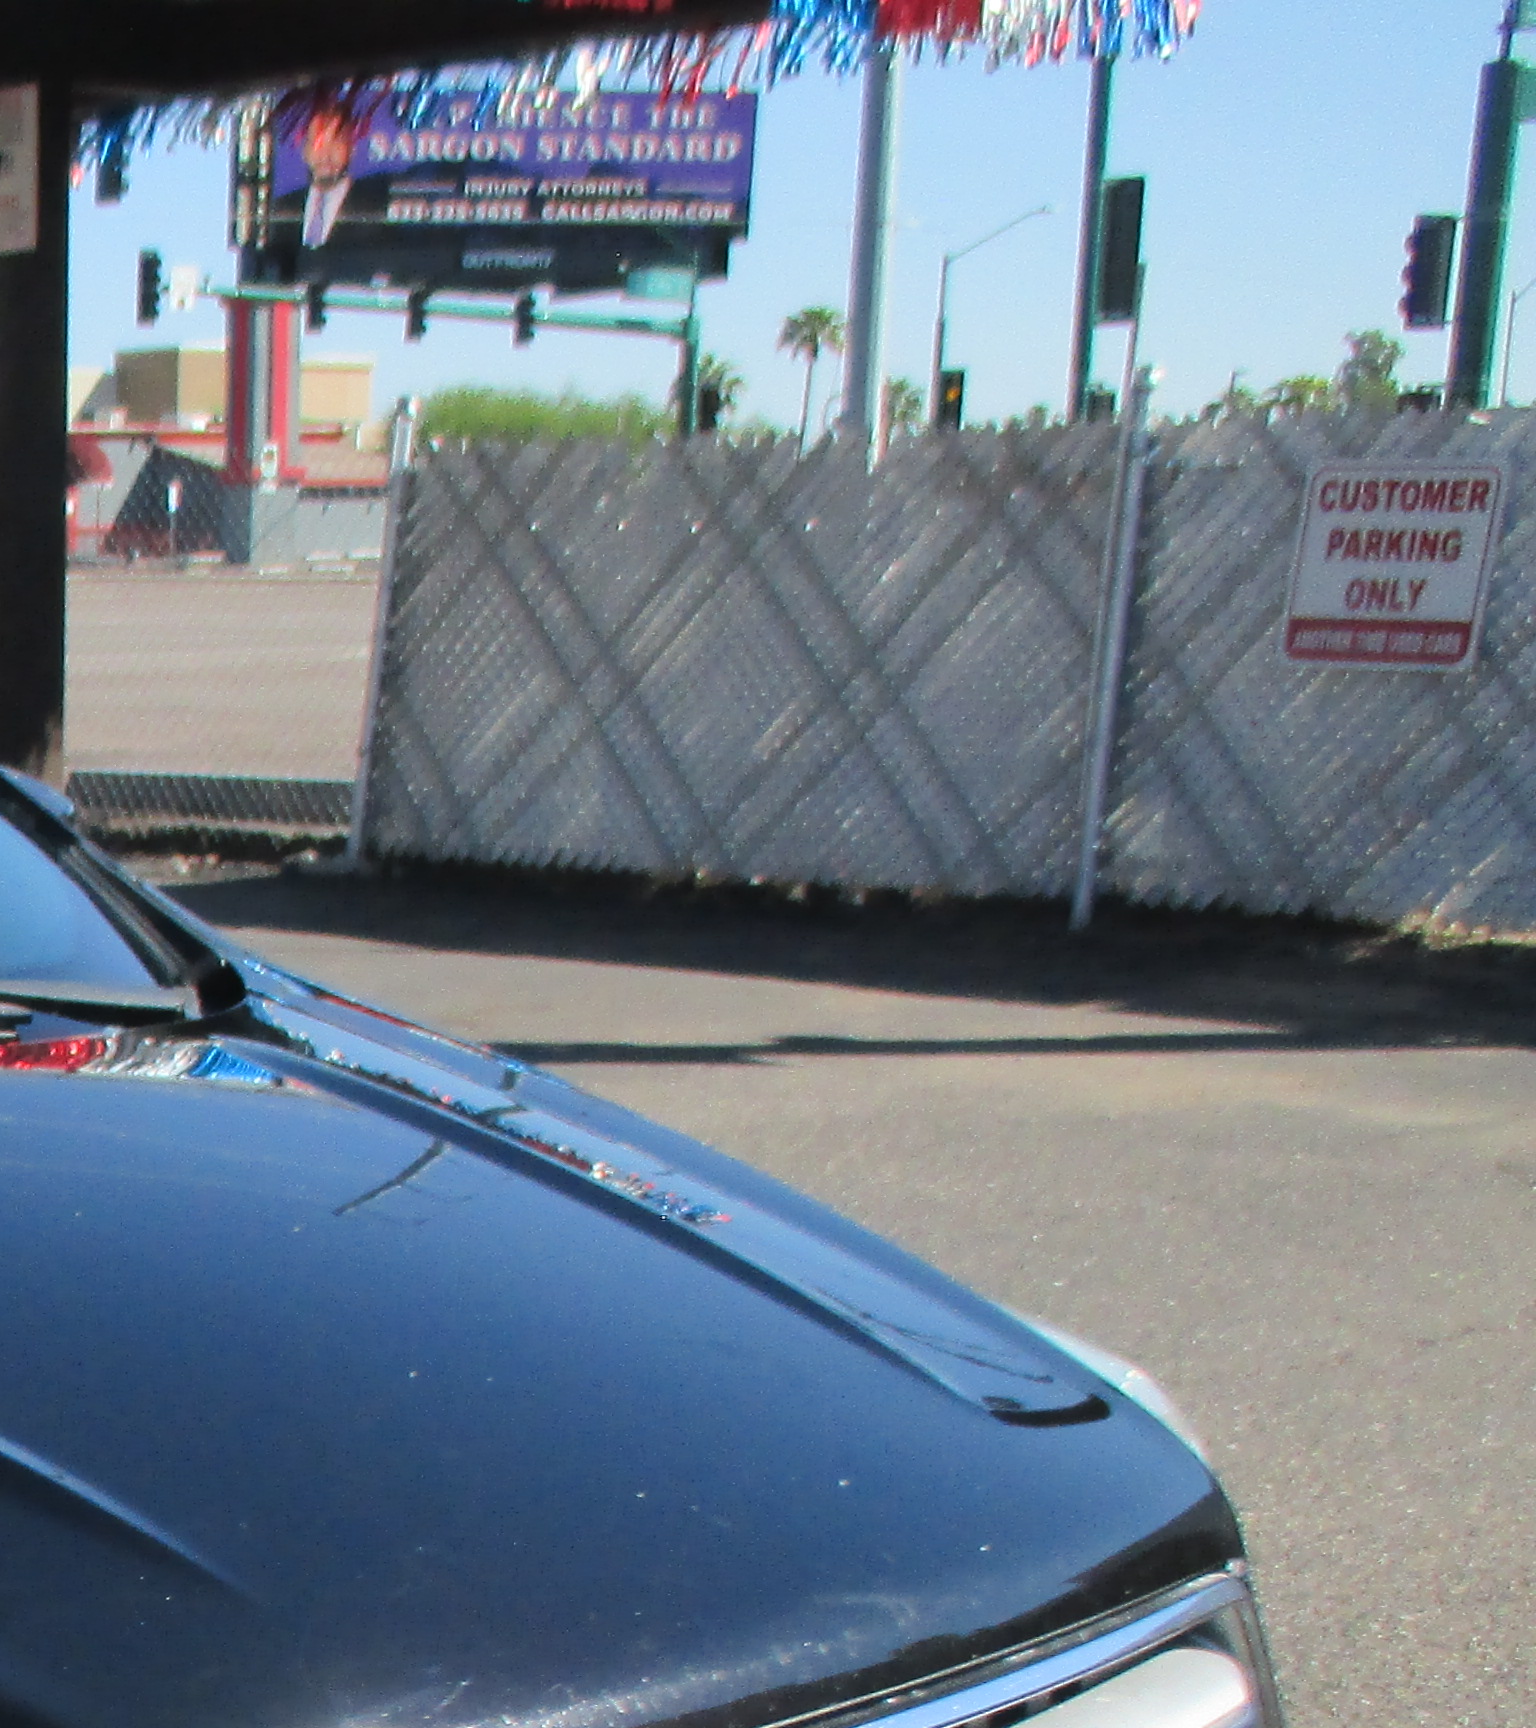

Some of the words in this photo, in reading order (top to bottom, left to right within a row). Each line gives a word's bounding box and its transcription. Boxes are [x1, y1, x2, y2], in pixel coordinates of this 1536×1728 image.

[368, 132, 525, 162] SARGON
[536, 132, 743, 162] STANDARD
[464, 177, 534, 197] INJURY
[536, 178, 648, 198] ATTORNEYS
[1318, 479, 1491, 513] CUSTOMER
[1325, 527, 1464, 563] PARKING
[1343, 577, 1428, 612] ONLY
